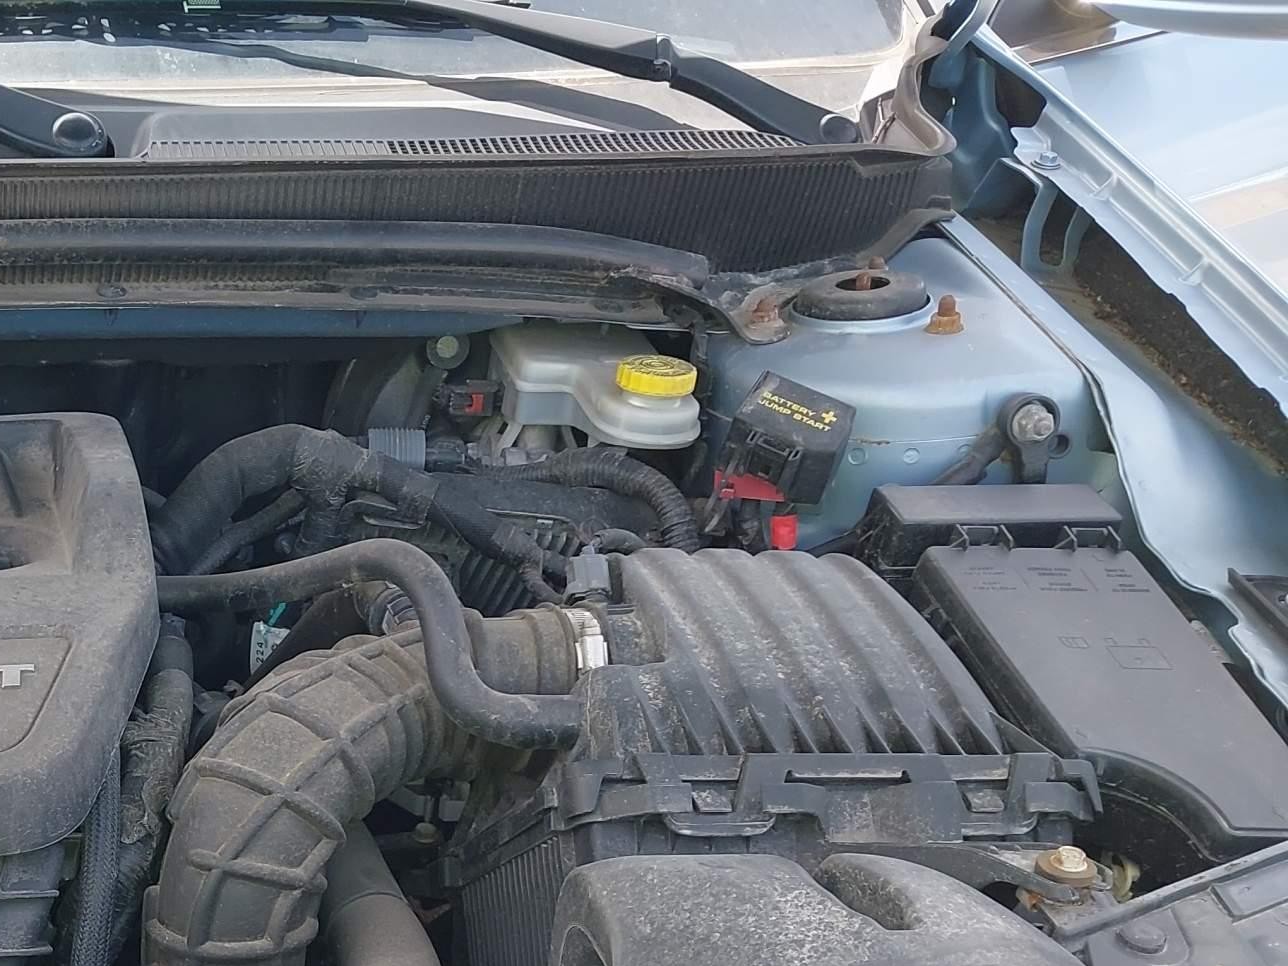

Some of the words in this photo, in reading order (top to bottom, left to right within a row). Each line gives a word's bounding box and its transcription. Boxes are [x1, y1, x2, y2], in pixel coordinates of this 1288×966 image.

[758, 399, 792, 415] JUMP
[792, 413, 832, 432] START
[762, 391, 817, 417] BATTERY
